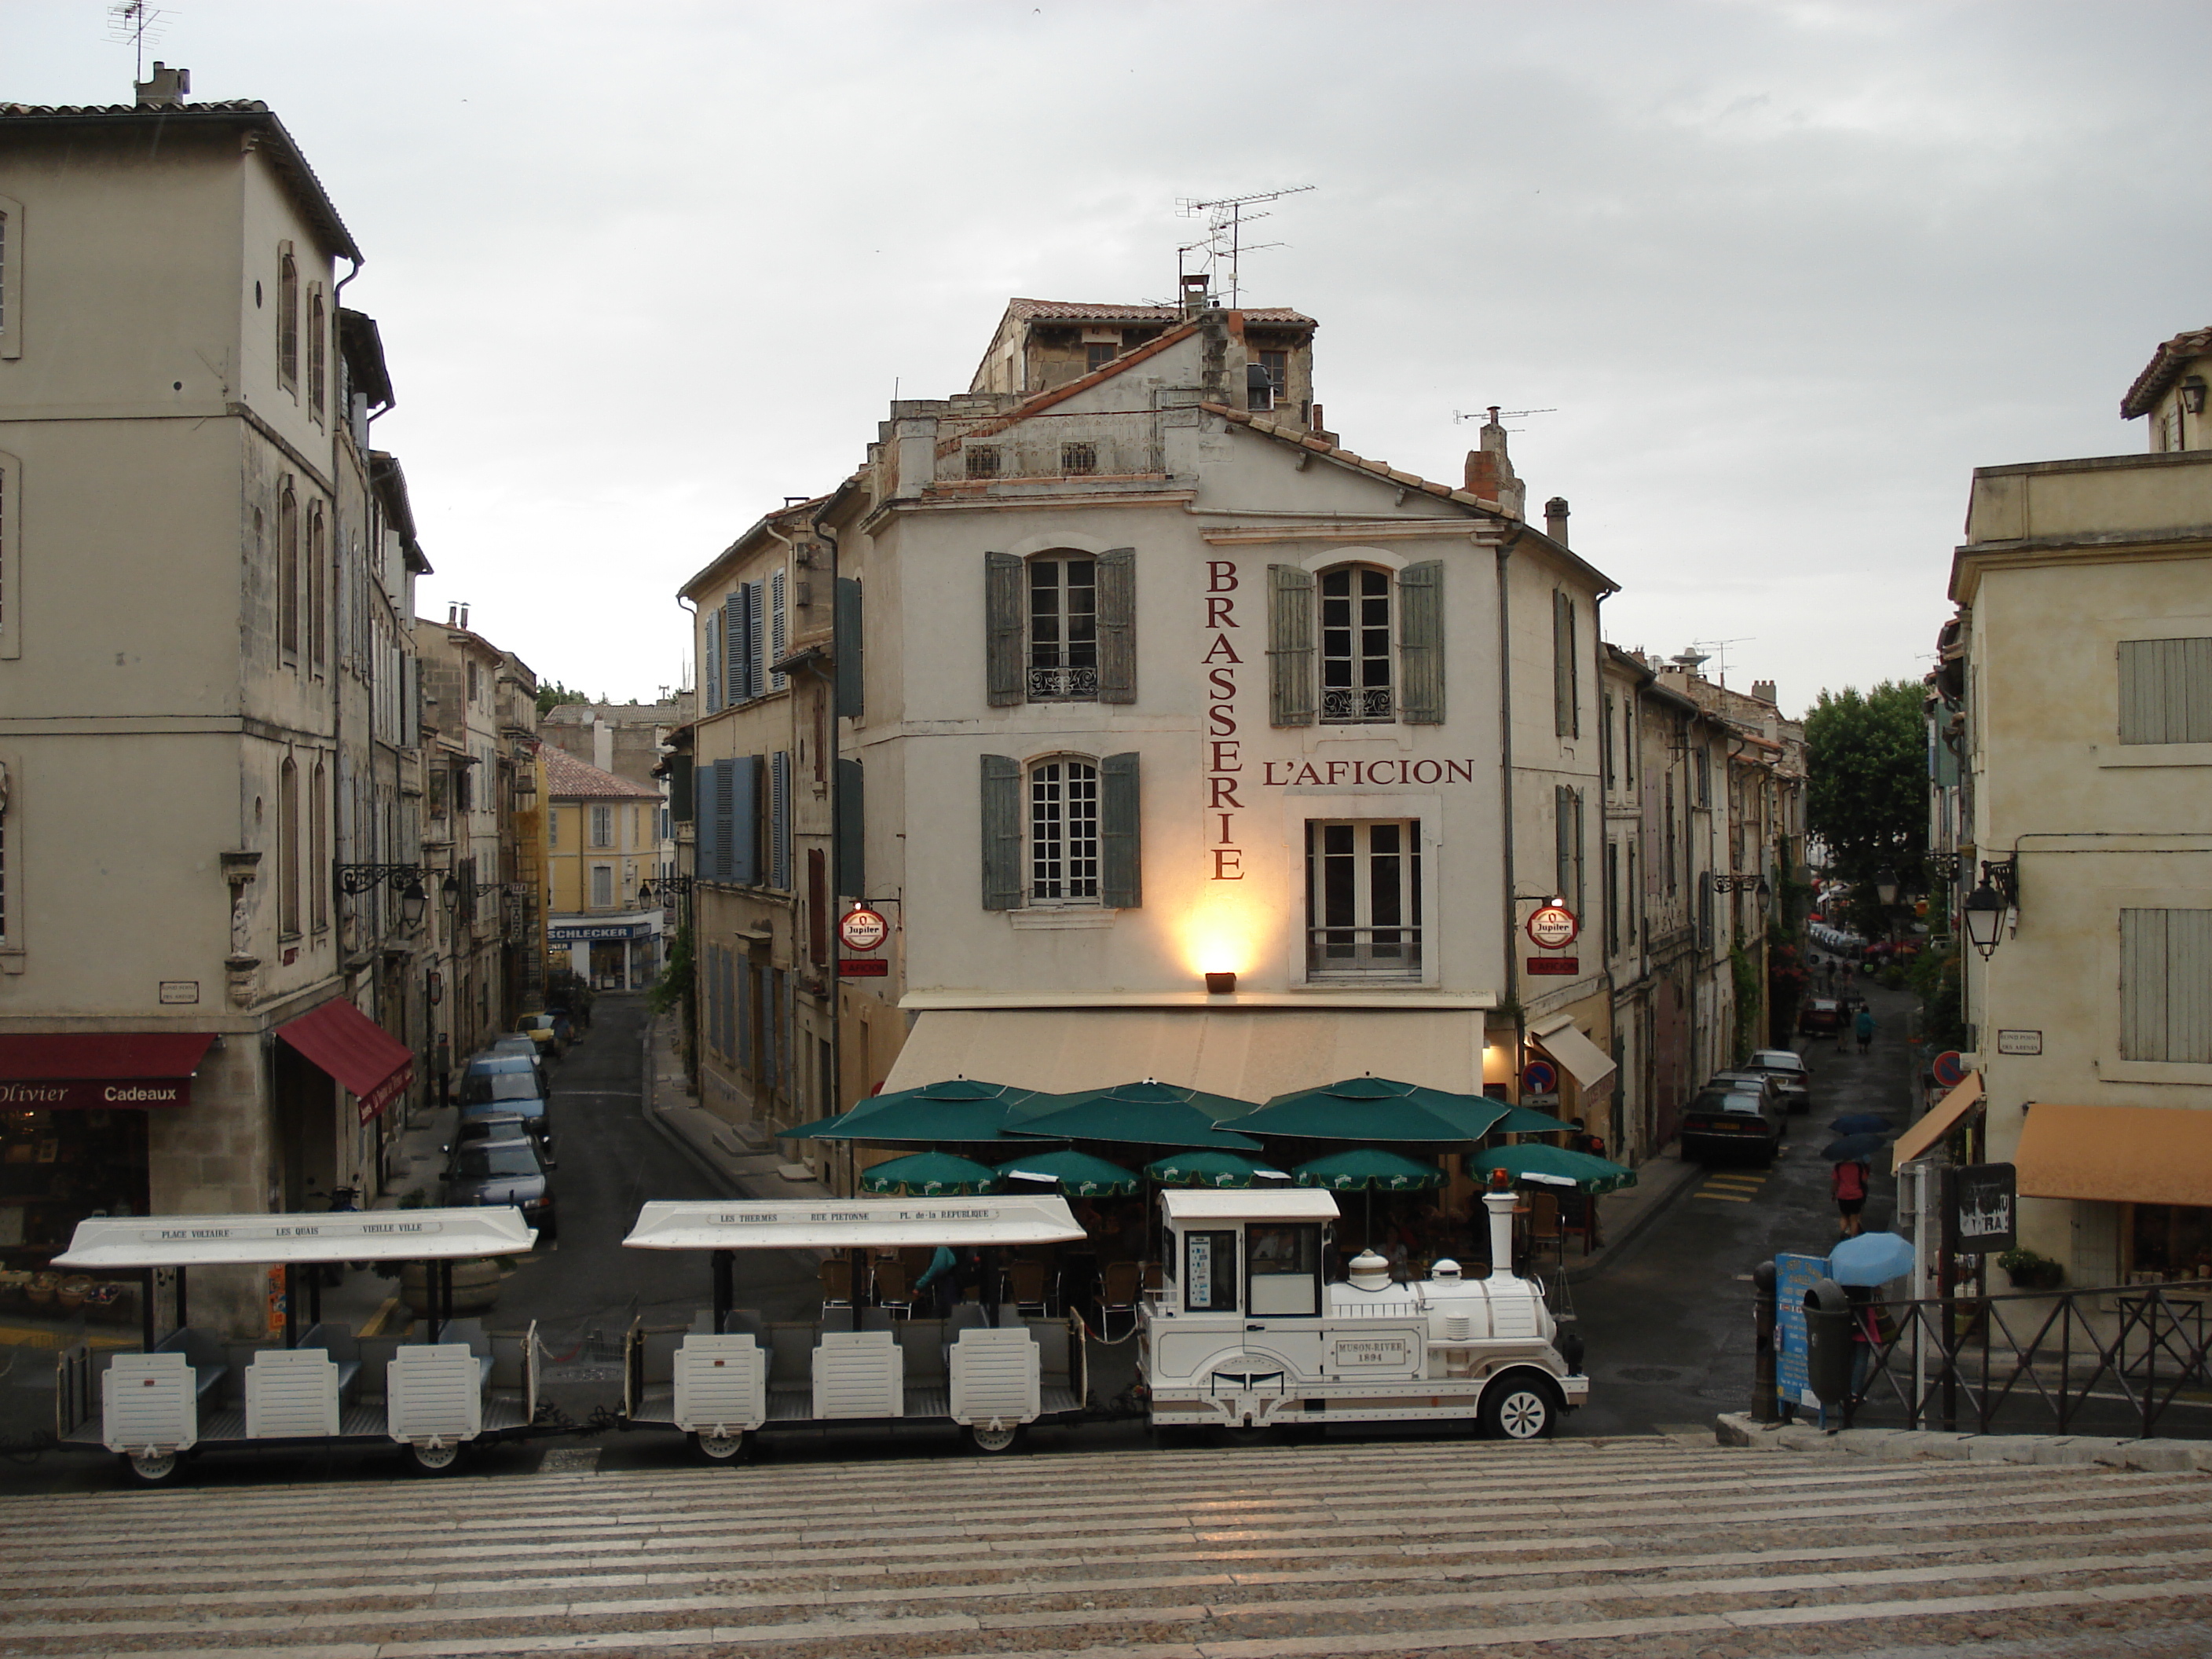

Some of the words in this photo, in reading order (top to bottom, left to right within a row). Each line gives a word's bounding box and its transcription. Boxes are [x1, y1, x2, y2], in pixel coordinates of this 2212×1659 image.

[1202, 561, 1245, 880] BRASSERIE
[848, 926, 879, 935] Jupiler
[1537, 923, 1569, 932] Jupiler
[548, 928, 627, 939] SCHLECKER
[0, 1083, 69, 1102] Olivier
[104, 1086, 177, 1102] Cadeaux
[739, 1214, 778, 1222] THERMES
[941, 1210, 989, 1218] REPUBLIQUE
[192, 1229, 230, 1238] VOLTAIRE
[276, 1228, 291, 1236] LES
[295, 1227, 319, 1236] QUAIS
[363, 1225, 394, 1233] VIEILLE
[399, 1223, 423, 1232] VILLE
[1339, 1342, 1403, 1353] MUSON-RIVER
[1358, 1353, 1382, 1362] 1894
